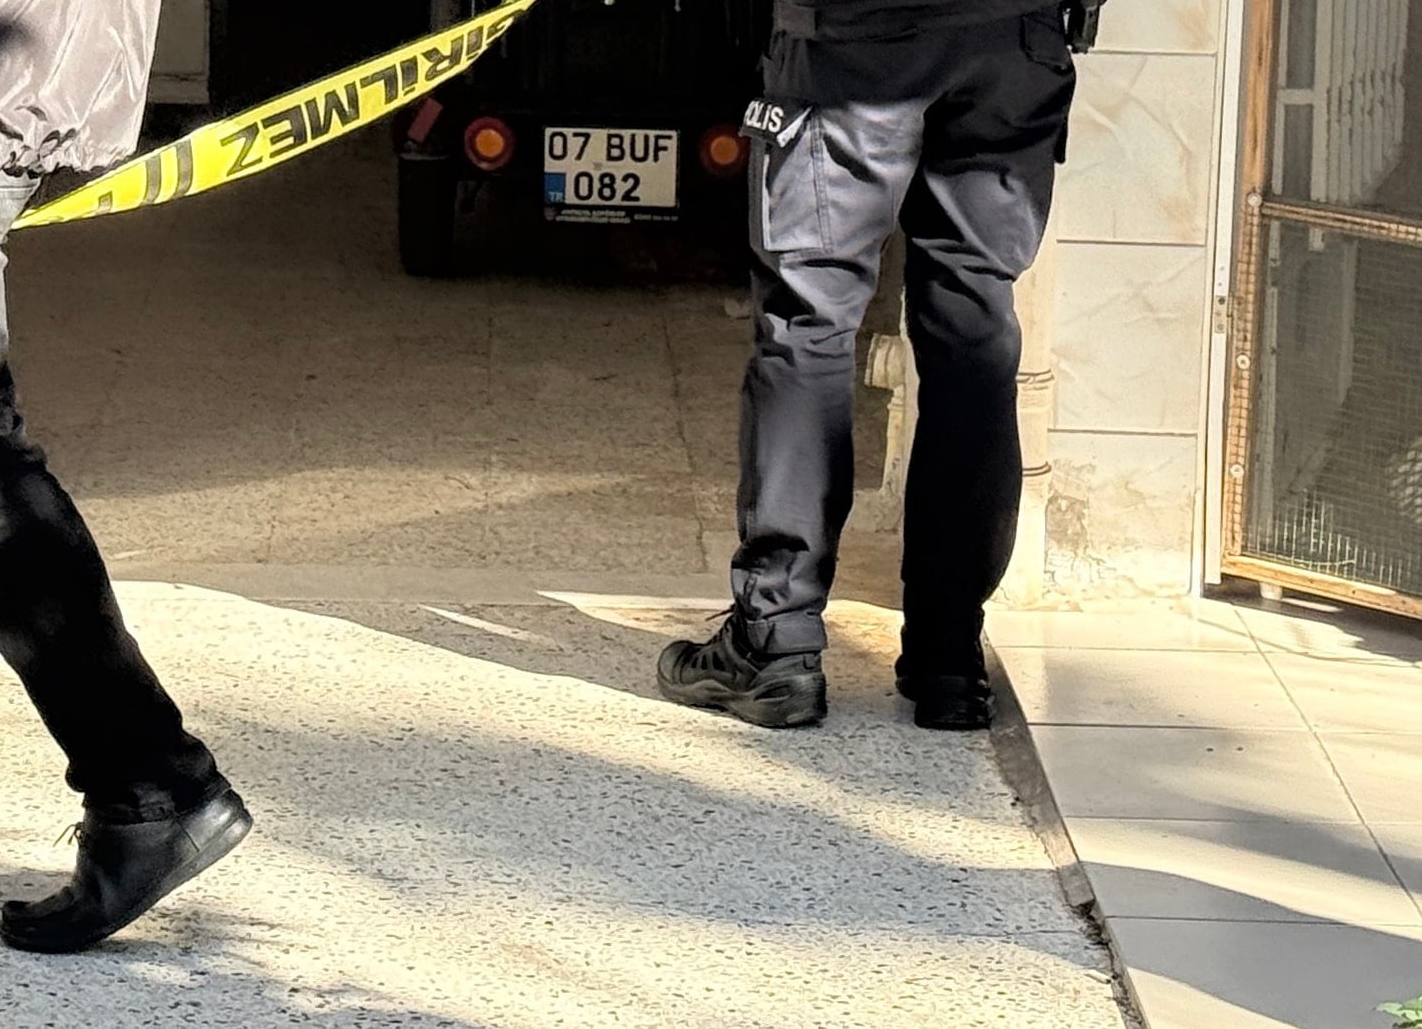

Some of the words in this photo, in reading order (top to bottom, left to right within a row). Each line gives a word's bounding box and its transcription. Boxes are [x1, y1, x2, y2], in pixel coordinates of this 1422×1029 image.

[548, 132, 591, 161] 07
[606, 133, 673, 163] BUF
[548, 192, 563, 203] TR
[574, 172, 641, 202] 082
